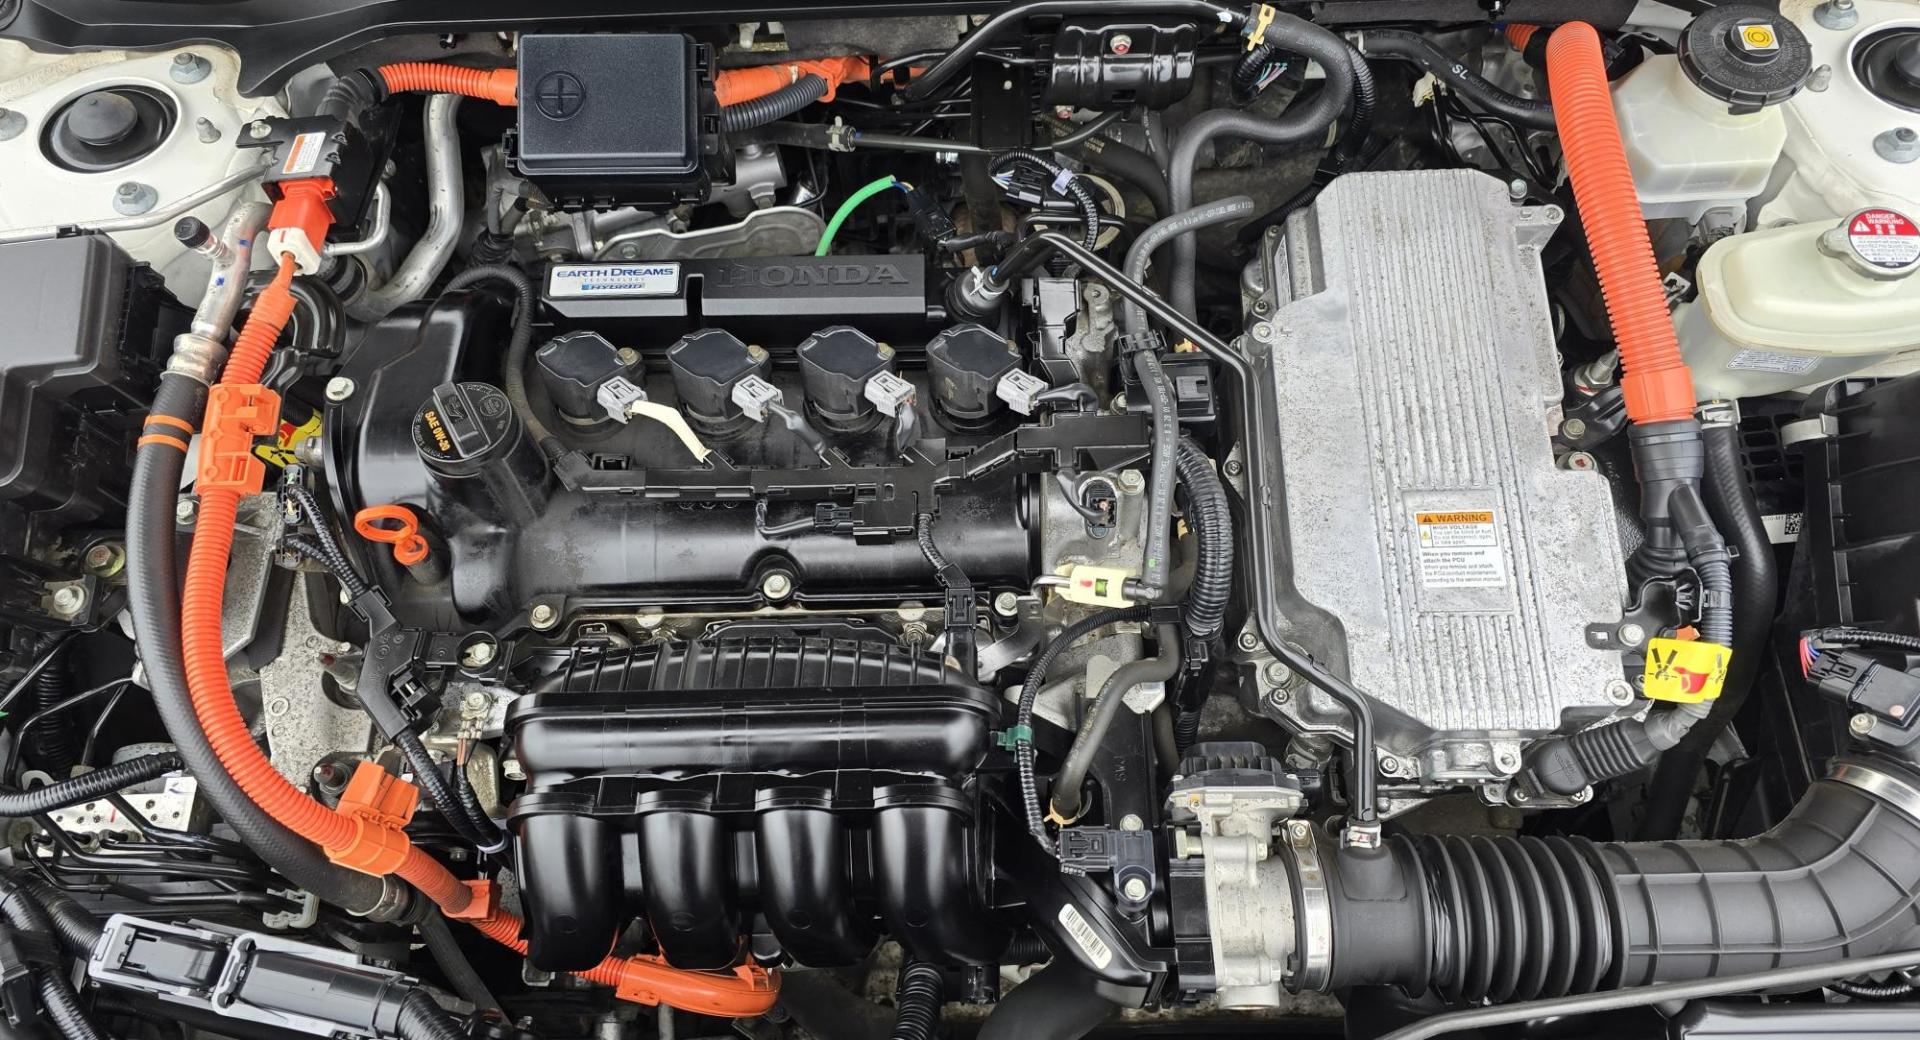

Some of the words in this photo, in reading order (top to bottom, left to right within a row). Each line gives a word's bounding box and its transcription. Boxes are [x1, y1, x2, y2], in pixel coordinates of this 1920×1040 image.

[1452, 64, 1468, 80] SL
[557, 269, 608, 278] EARTH
[611, 267, 674, 277] DREAMS
[717, 263, 910, 288] HONDA
[424, 410, 440, 429] SAE
[1436, 514, 1487, 522] WARNING
